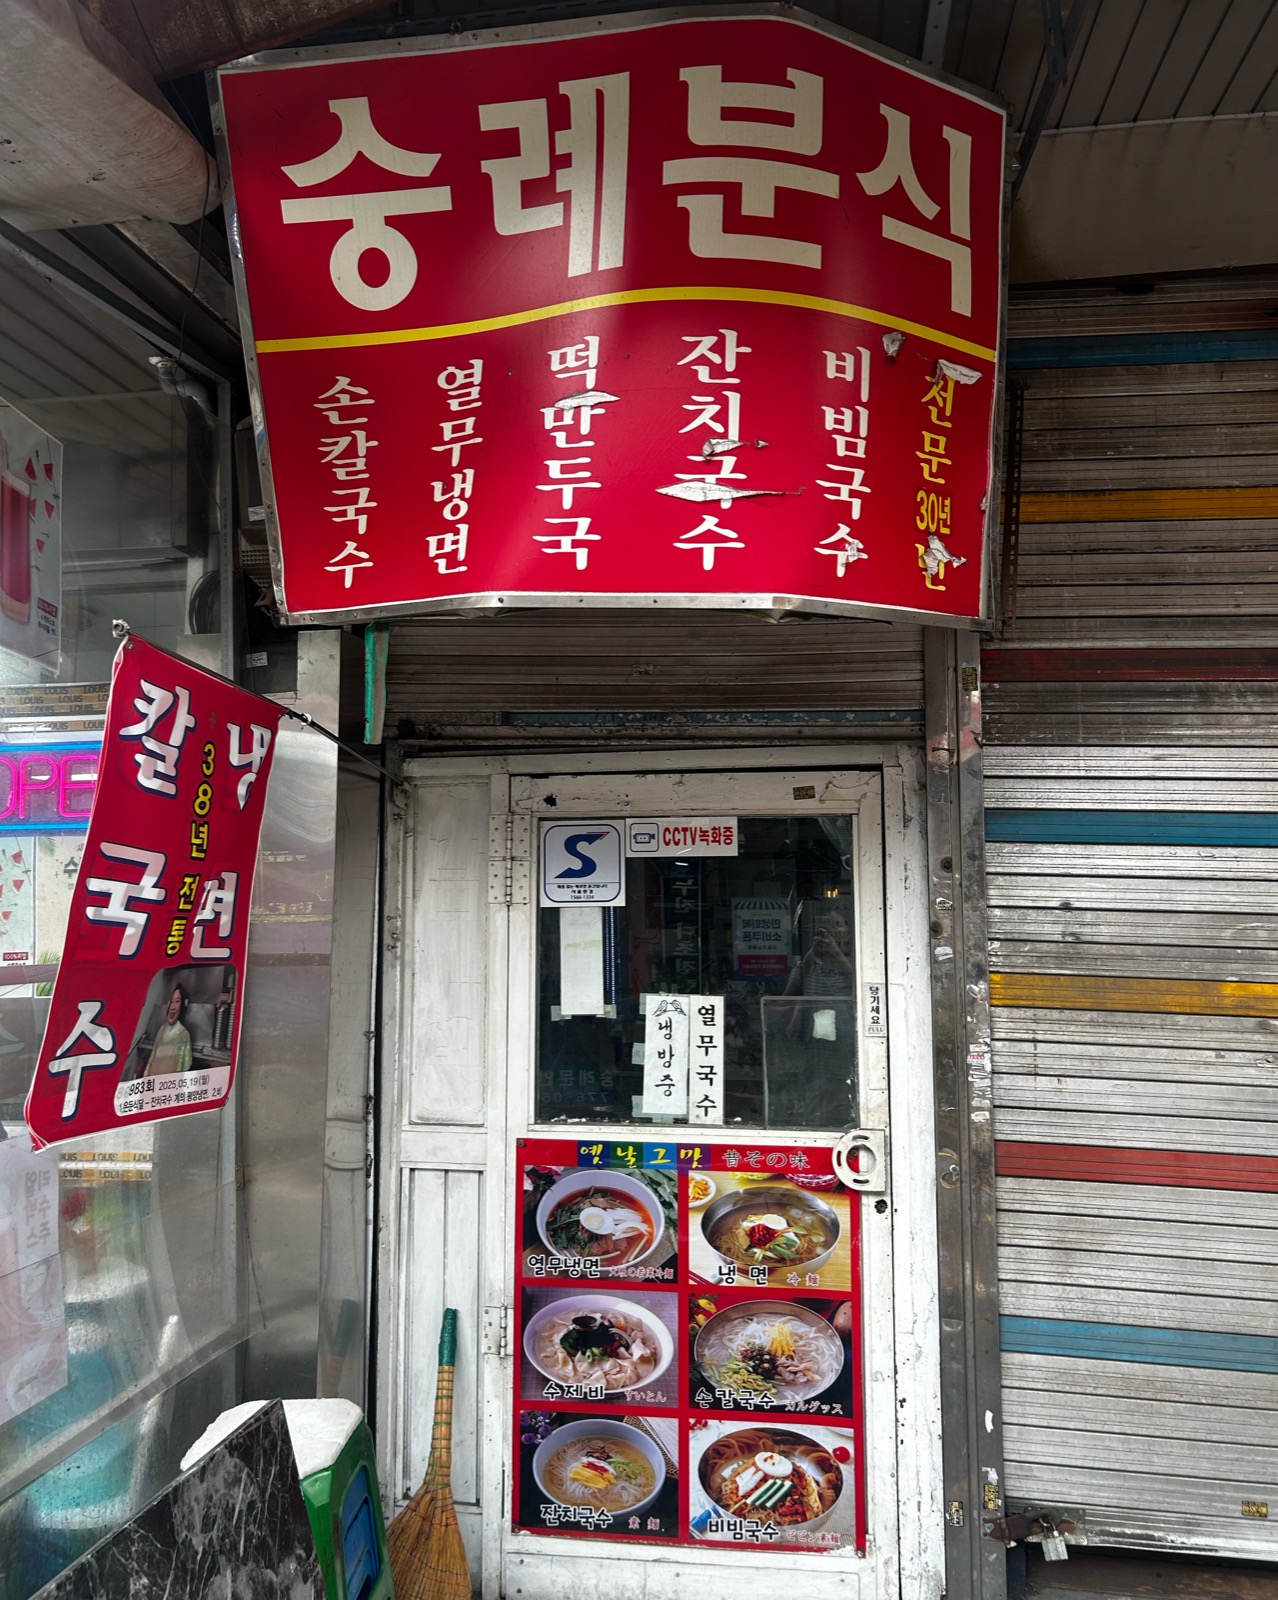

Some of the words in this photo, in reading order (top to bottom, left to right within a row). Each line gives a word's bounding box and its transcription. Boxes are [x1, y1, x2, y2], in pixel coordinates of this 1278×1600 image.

[280, 65, 972, 317] 숭례분식
[314, 376, 379, 588] 손칼국수
[425, 359, 483, 574] 열무냉면
[532, 336, 605, 570] 떡만두국
[672, 329, 752, 570] 잔치국수
[814, 346, 871, 577] 비빔국수
[916, 490, 951, 534] 30년
[70, 704, 94, 712] LOUIS
[190, 722, 272, 959] 냉면
[50, 679, 196, 1119] 칼국수
[167, 875, 200, 956] 전통
[869, 986, 881, 1025] 당기세요
[655, 1016, 676, 1097] 냉방중
[696, 1004, 718, 1118] 열무국수
[528, 1254, 600, 1277] 열무냉면
[543, 1382, 605, 1401] 수제비
[694, 1387, 776, 1410] 손칼국수
[540, 1504, 613, 1528] 잔치국수
[708, 1518, 780, 1543] 비빔국수
